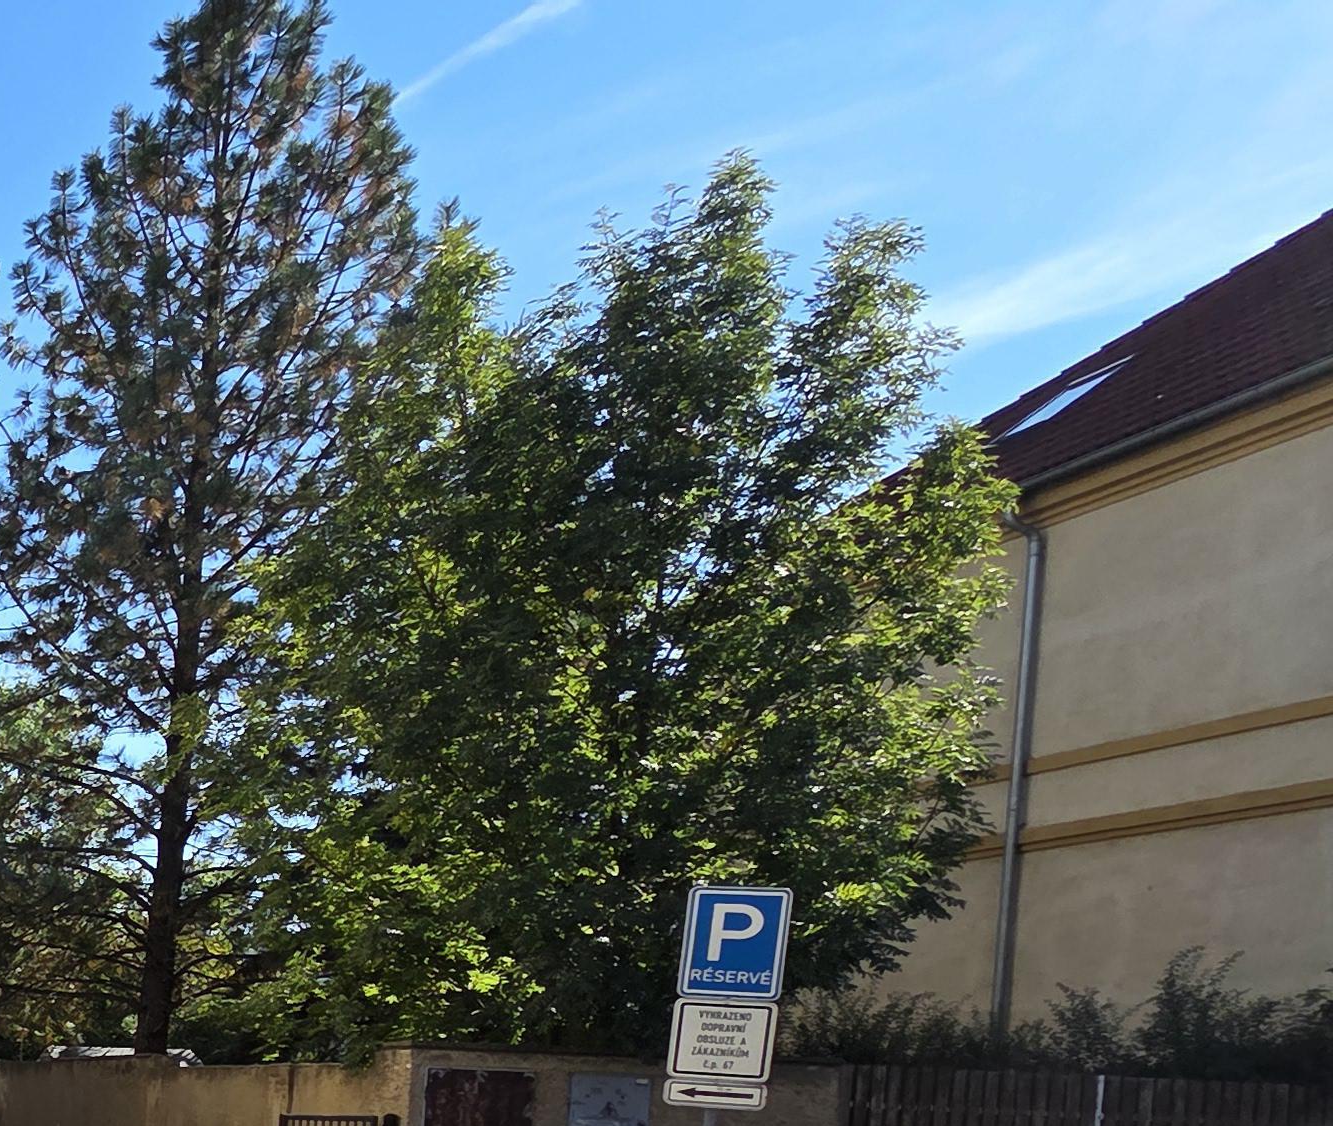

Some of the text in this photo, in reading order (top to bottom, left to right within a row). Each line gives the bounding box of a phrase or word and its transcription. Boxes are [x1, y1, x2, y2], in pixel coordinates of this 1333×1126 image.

[706, 902, 766, 962] P
[690, 967, 772, 986] RÉSERVÉ
[699, 1010, 752, 1022] VYHRAZENO
[701, 1022, 747, 1033] DOPRAVNÍ
[696, 1034, 747, 1046] OBSLUZE A
[691, 1045, 749, 1058] ZÁKAZNÍKŮM
